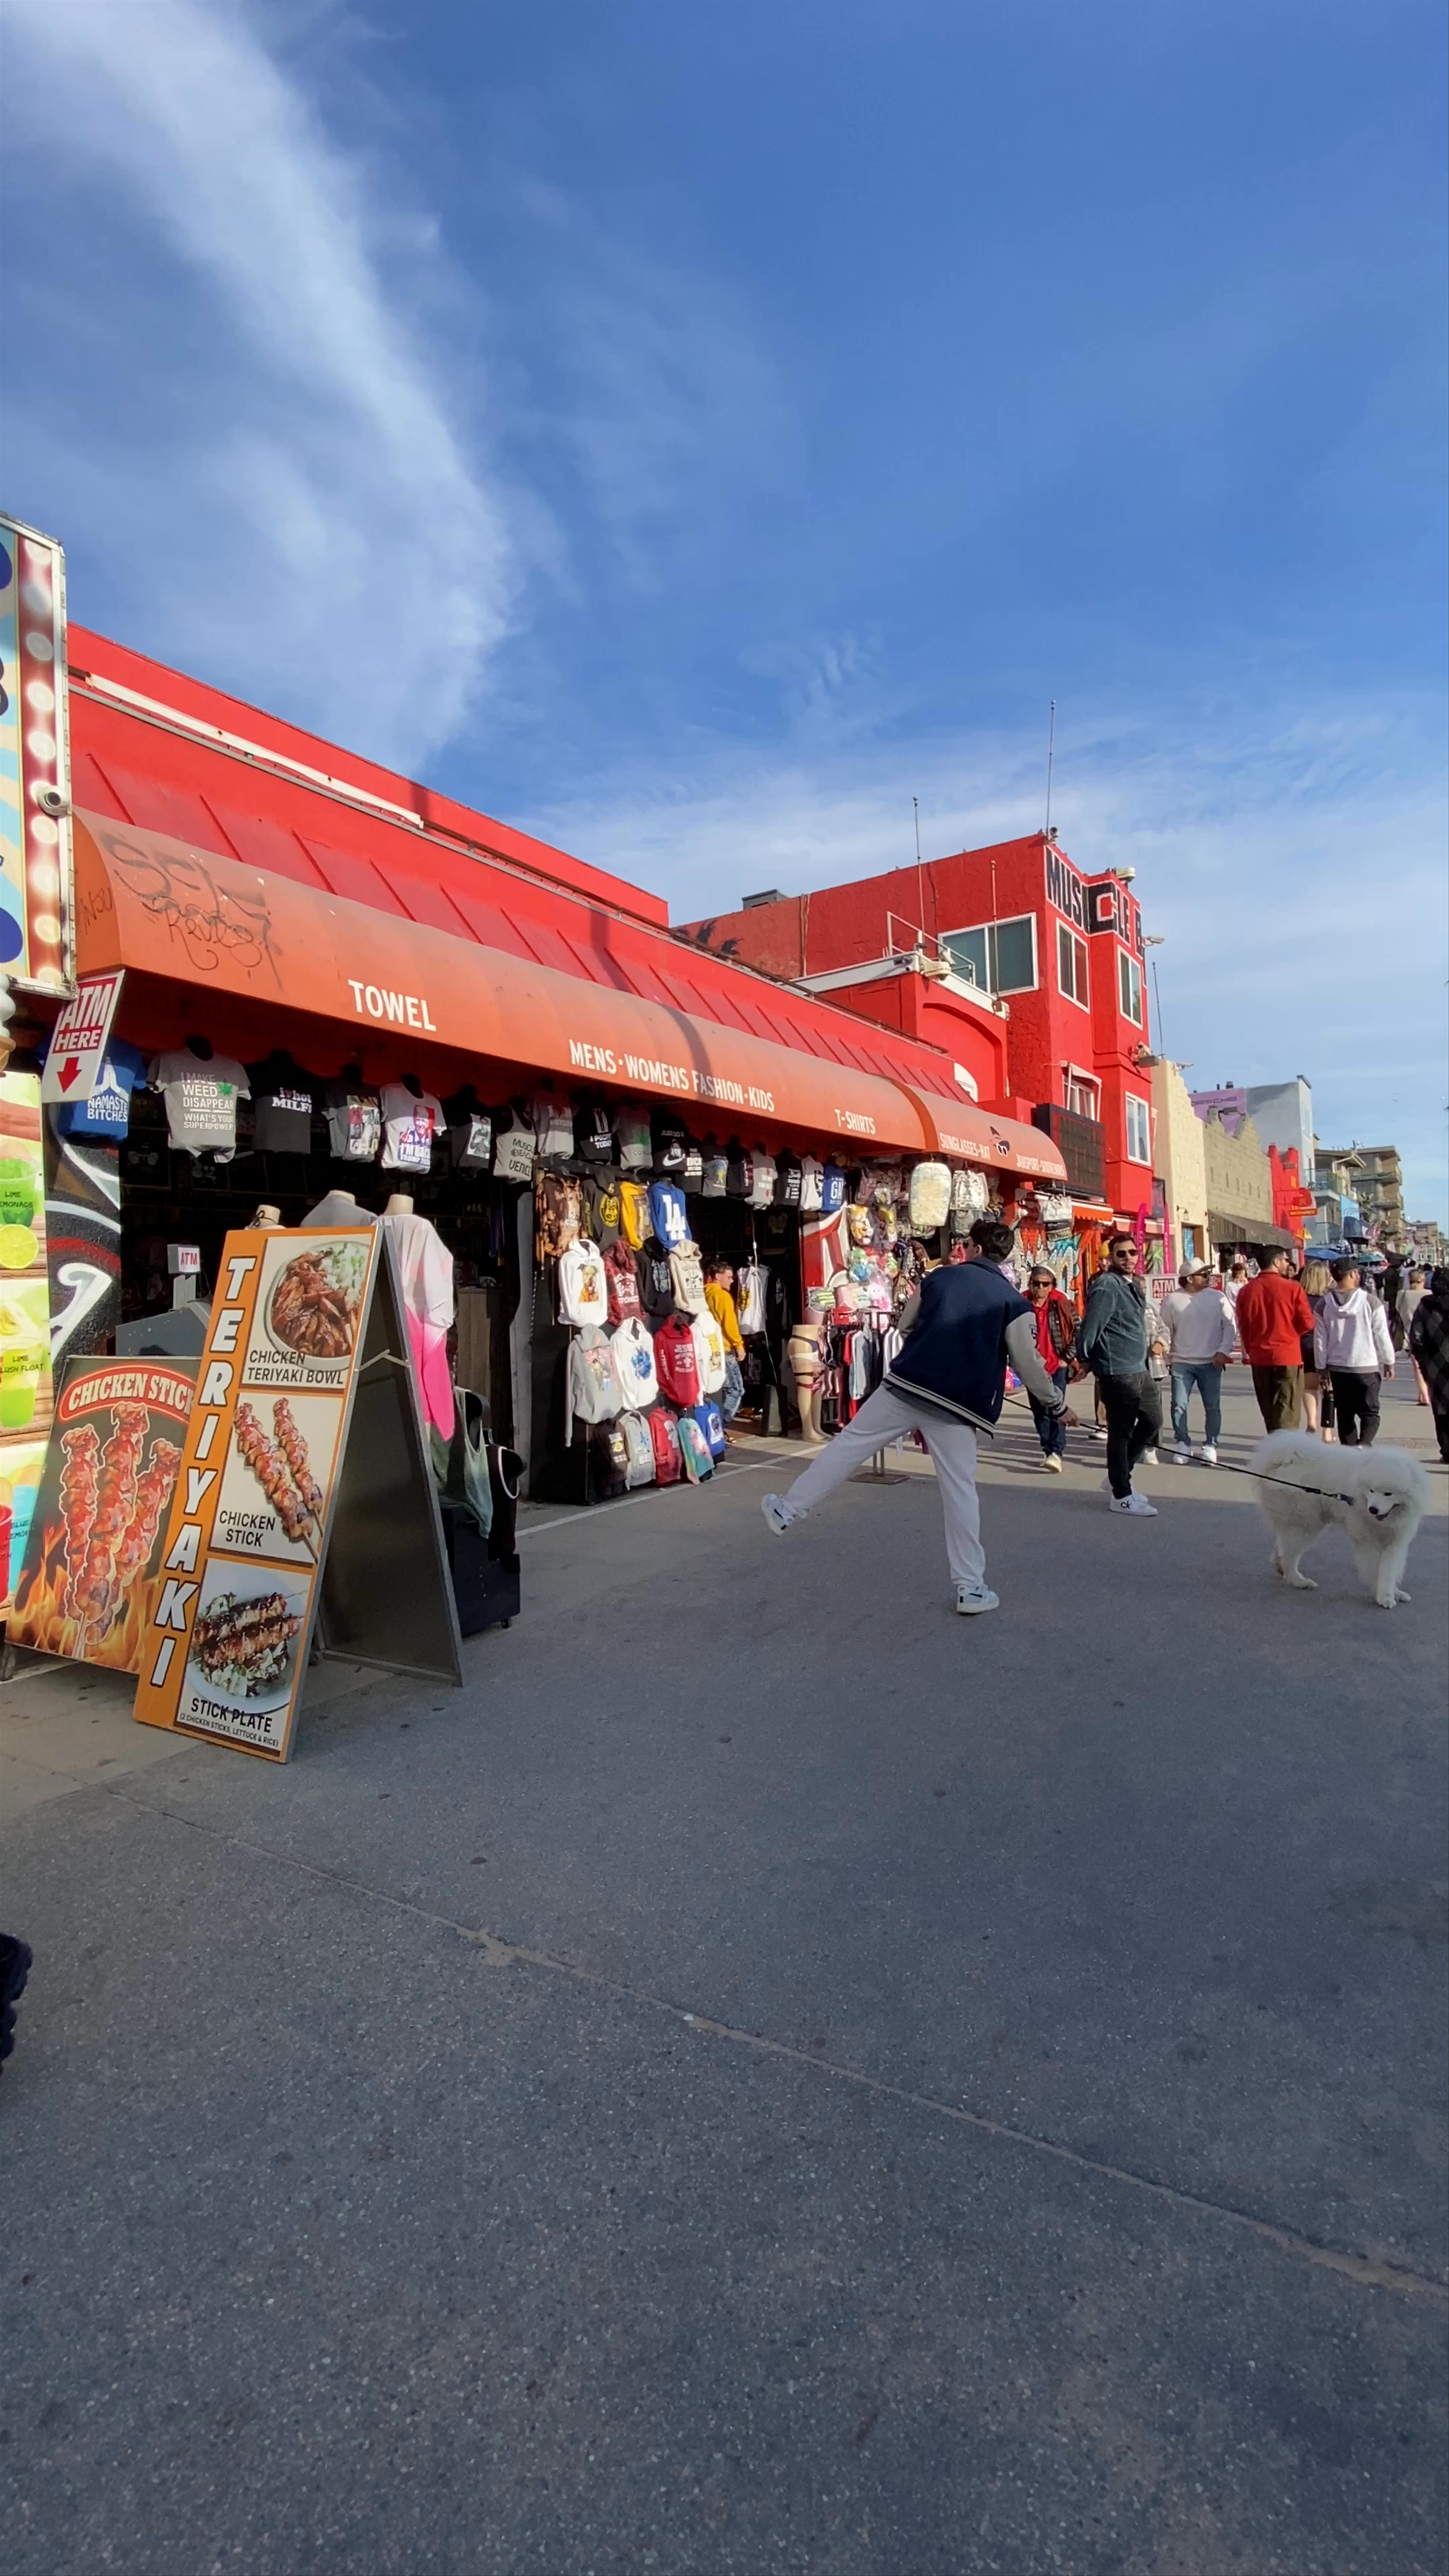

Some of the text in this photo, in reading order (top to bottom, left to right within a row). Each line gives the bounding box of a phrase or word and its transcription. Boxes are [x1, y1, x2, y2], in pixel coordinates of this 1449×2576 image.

[1044, 844, 1131, 948] MUSCLE
[60, 983, 113, 1031] ATM
[348, 979, 437, 1032] TOWEL
[55, 1029, 102, 1051] HERE
[181, 1072, 217, 1085] I MAKE
[182, 1084, 218, 1097] WEED
[87, 1095, 128, 1110] NAMASTE
[183, 1097, 234, 1109] DISAPPEAR
[1191, 1096, 1237, 1107] ORSCHE
[87, 1108, 128, 1123] BITCHES
[184, 1113, 234, 1123] WHAT'S YOU
[834, 1109, 876, 1135] T-SHIRTS
[662, 1194, 687, 1241] LA
[181, 1252, 198, 1266] ATM
[1153, 1279, 1174, 1293] ATM
[249, 1350, 306, 1366] CHICKEN
[21, 1363, 43, 1372] FLOAT
[248, 1367, 344, 1385] TERIYAKI BOWL
[69, 1373, 148, 1411] CHICKEN
[150, 1256, 257, 1688] TERIYAKI
[219, 1510, 275, 1531] CHICKEN
[226, 1529, 264, 1547] STICK
[191, 1697, 272, 1733] STICK PLATE
[186, 1714, 210, 1727] CHICKEN
[211, 1721, 231, 1735] STICKS,
[232, 1728, 258, 1741] LETTUCE
[263, 1736, 279, 1748] RICE)
